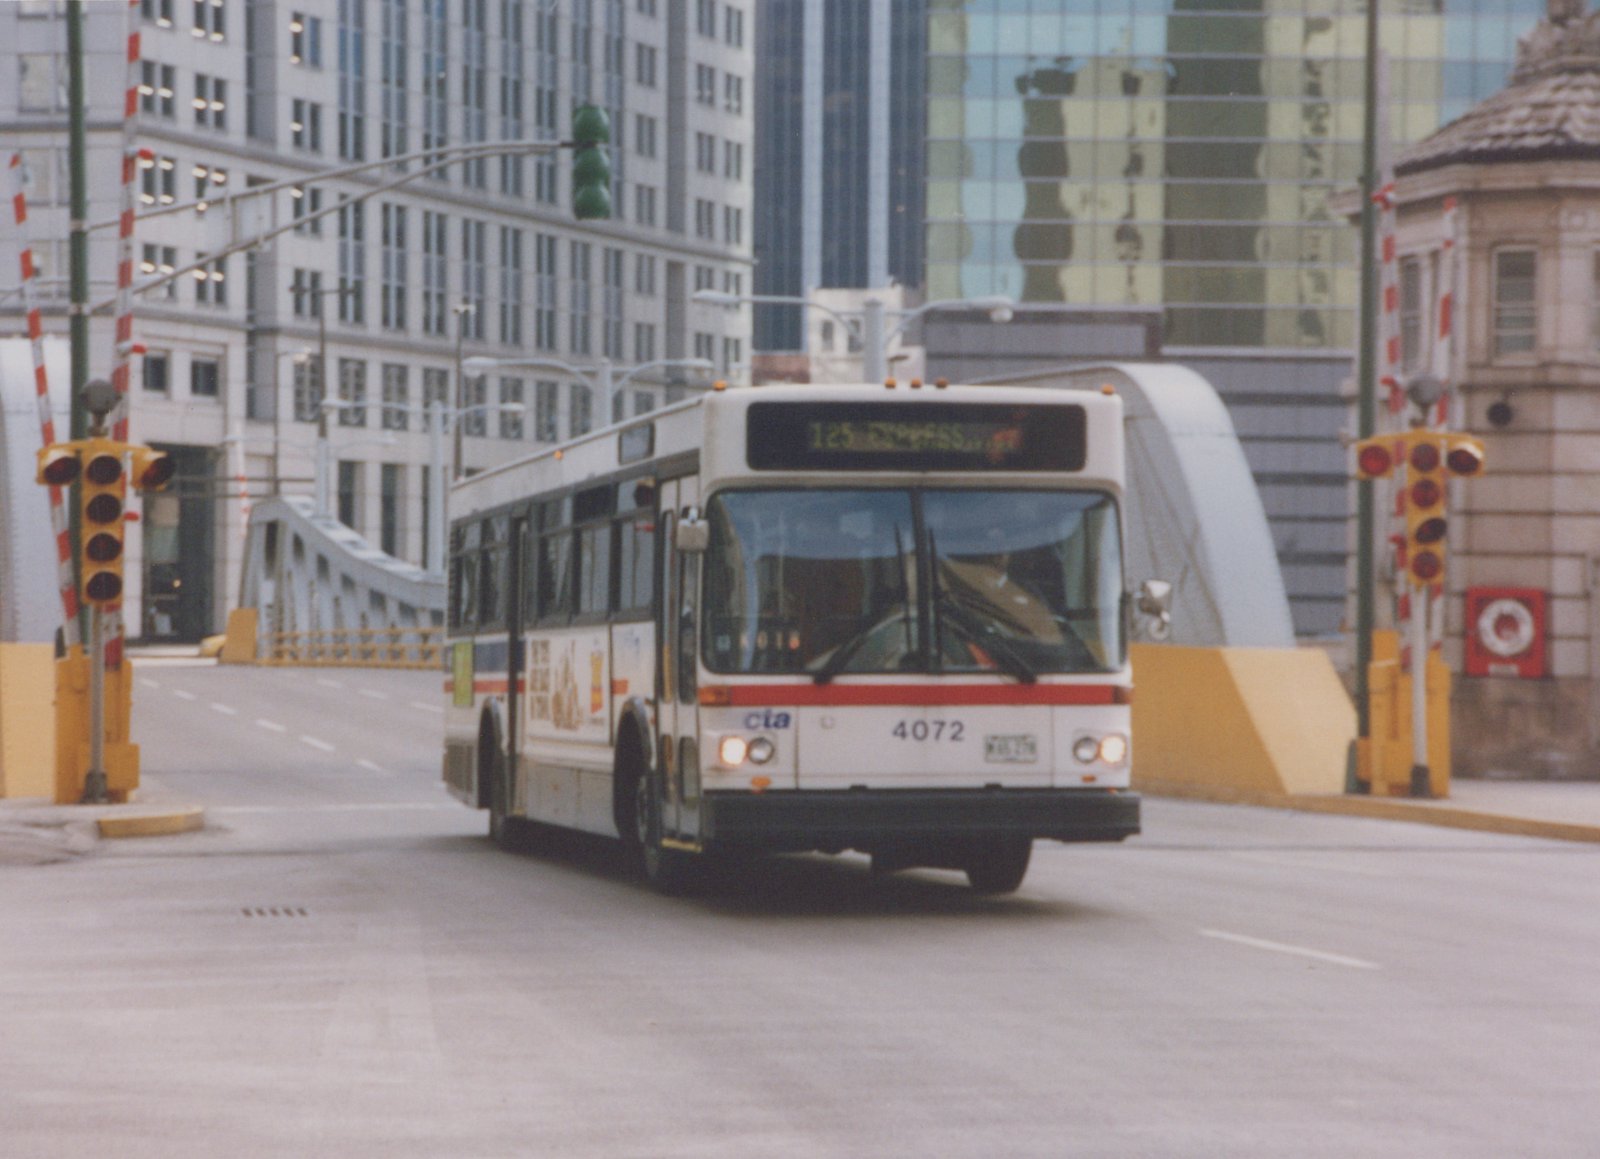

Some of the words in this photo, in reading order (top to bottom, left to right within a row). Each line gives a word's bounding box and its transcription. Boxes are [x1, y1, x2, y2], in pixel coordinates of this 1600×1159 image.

[812, 421, 855, 450] 125
[743, 708, 791, 730] cta
[892, 720, 965, 742] 4072
